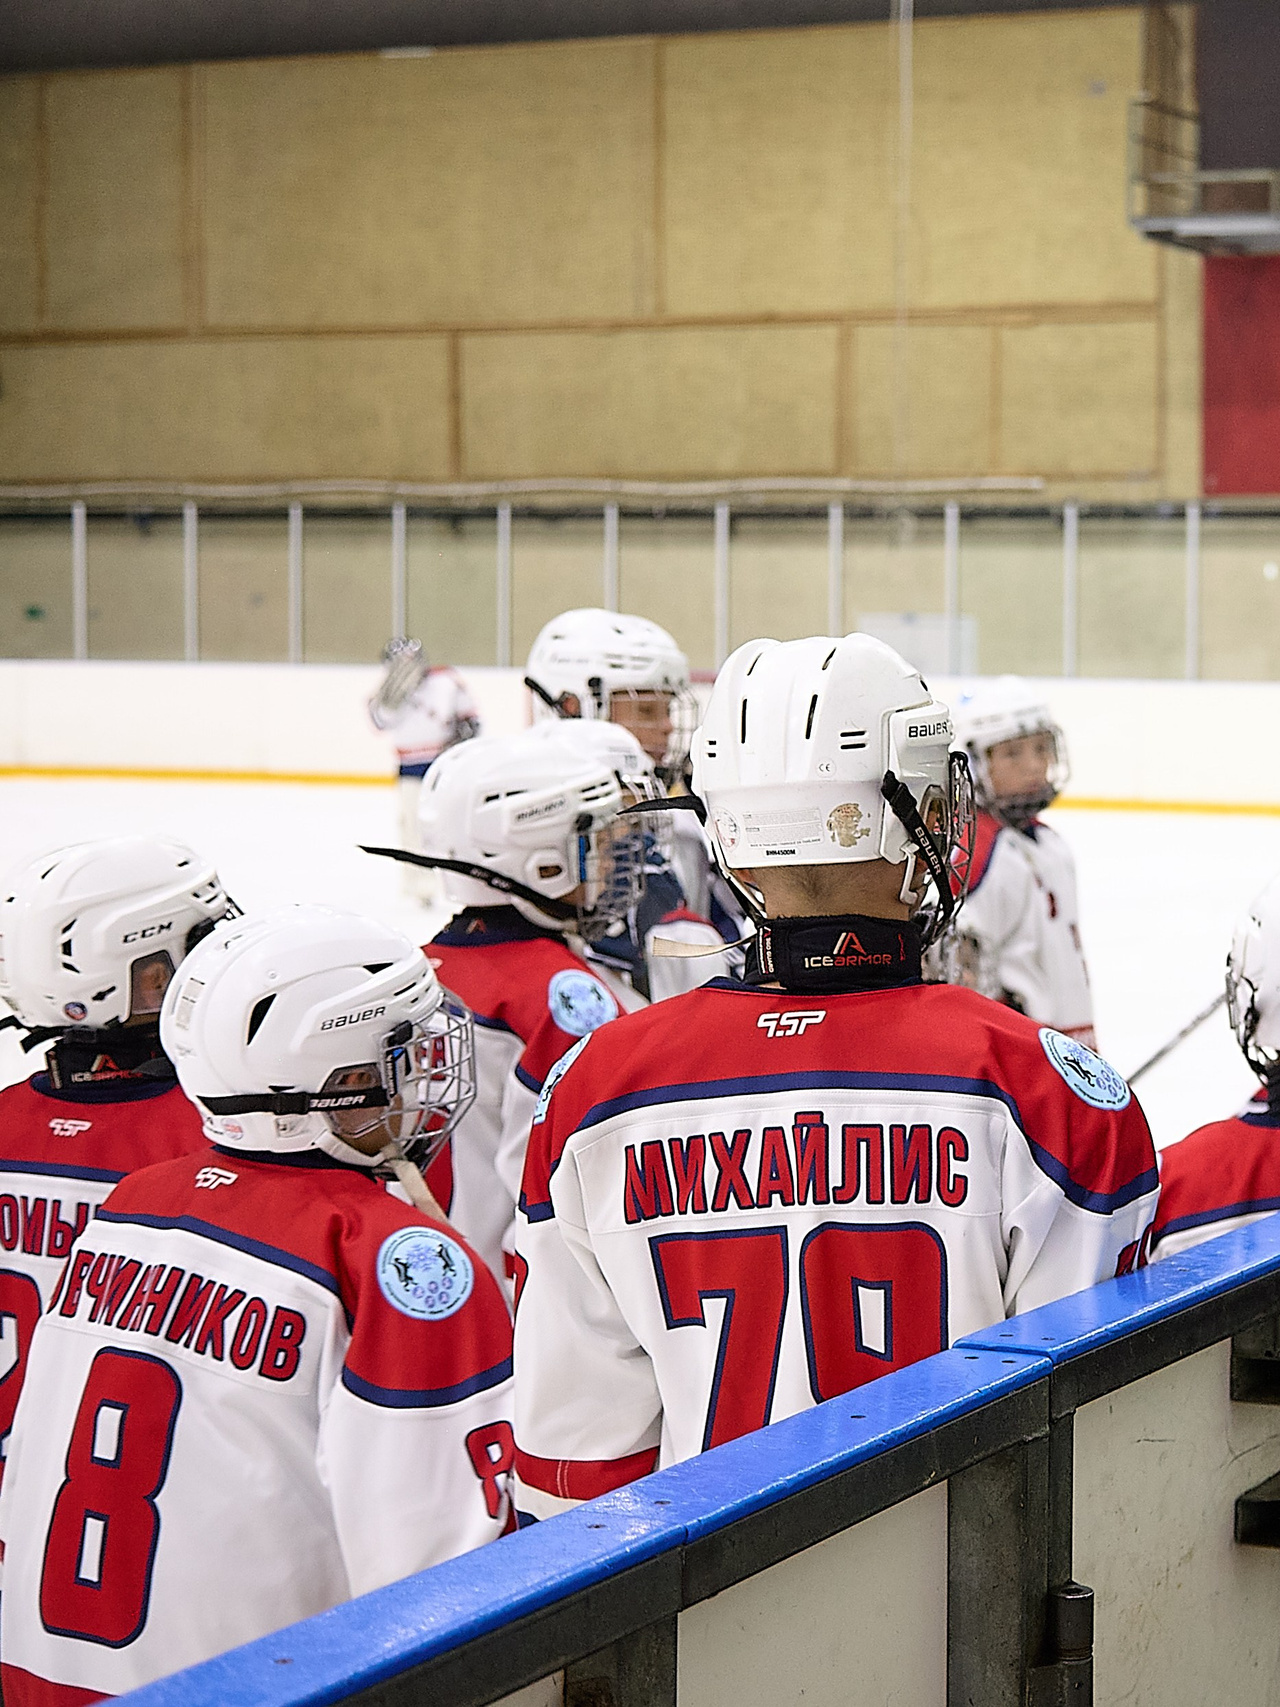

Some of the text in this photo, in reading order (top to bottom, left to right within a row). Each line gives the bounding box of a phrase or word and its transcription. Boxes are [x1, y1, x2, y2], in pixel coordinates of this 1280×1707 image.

[122, 921, 173, 944] CCM
[624, 1111, 969, 1224] МИХАЙЛИС
[39, 1345, 182, 1651] 8
